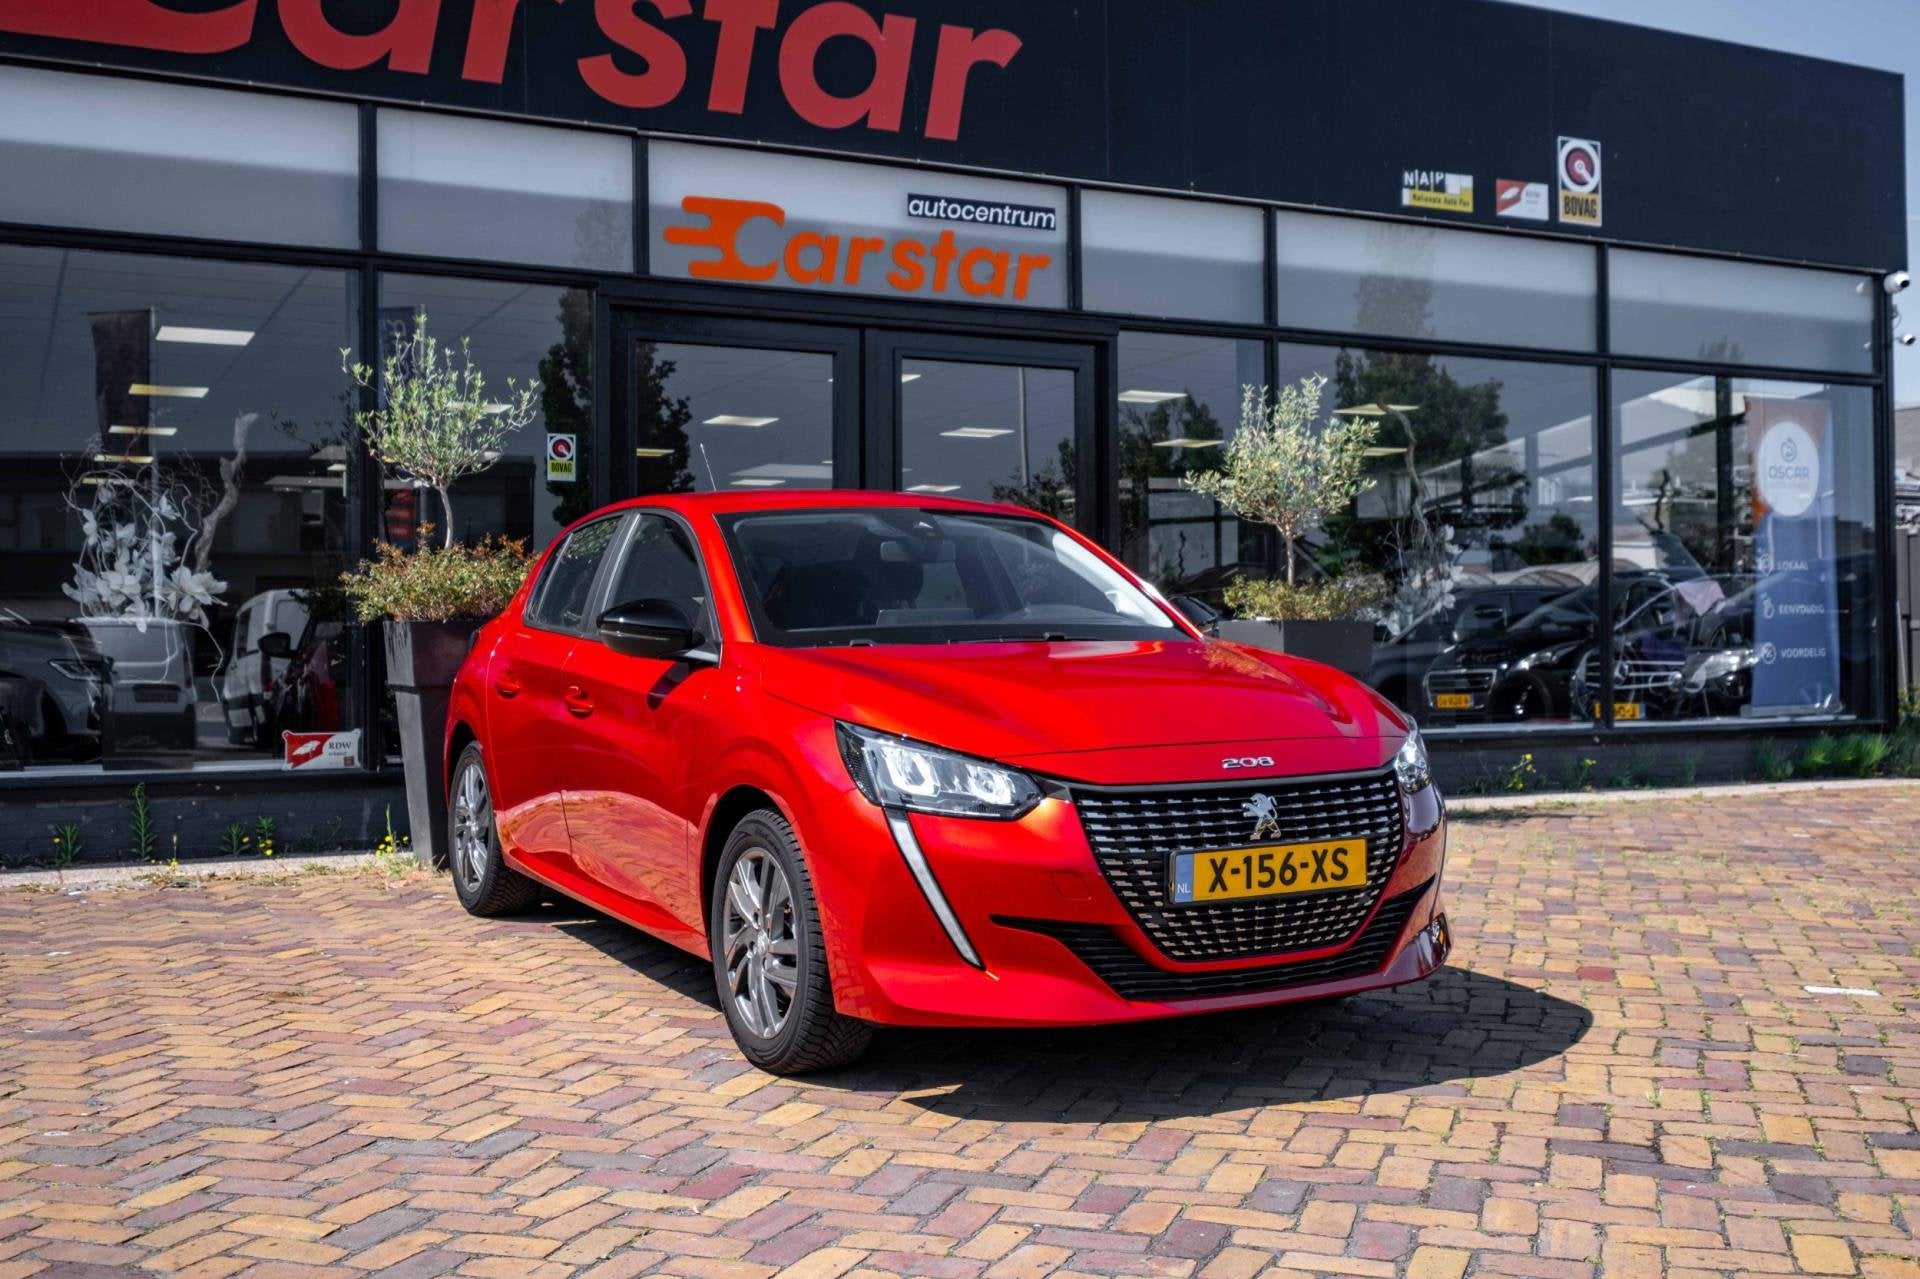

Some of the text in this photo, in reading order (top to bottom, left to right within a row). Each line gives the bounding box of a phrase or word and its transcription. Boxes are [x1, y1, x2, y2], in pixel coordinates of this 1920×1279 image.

[0, 0, 1022, 142] arstar
[908, 198, 1055, 229] autocentrum
[1564, 195, 1598, 219] BOVAG
[663, 196, 1051, 300] Carstar
[551, 462, 572, 473] BOVAG
[1768, 465, 1809, 480] OSCAR
[1777, 560, 1809, 571] LOKAAL
[1779, 604, 1825, 615] EENVOUDIG
[1781, 647, 1827, 658] VOORDELIG
[328, 741, 352, 750] RDW
[1221, 756, 1275, 769] 208
[1208, 847, 1350, 894] X-156-XS
[1177, 883, 1191, 894] NL
